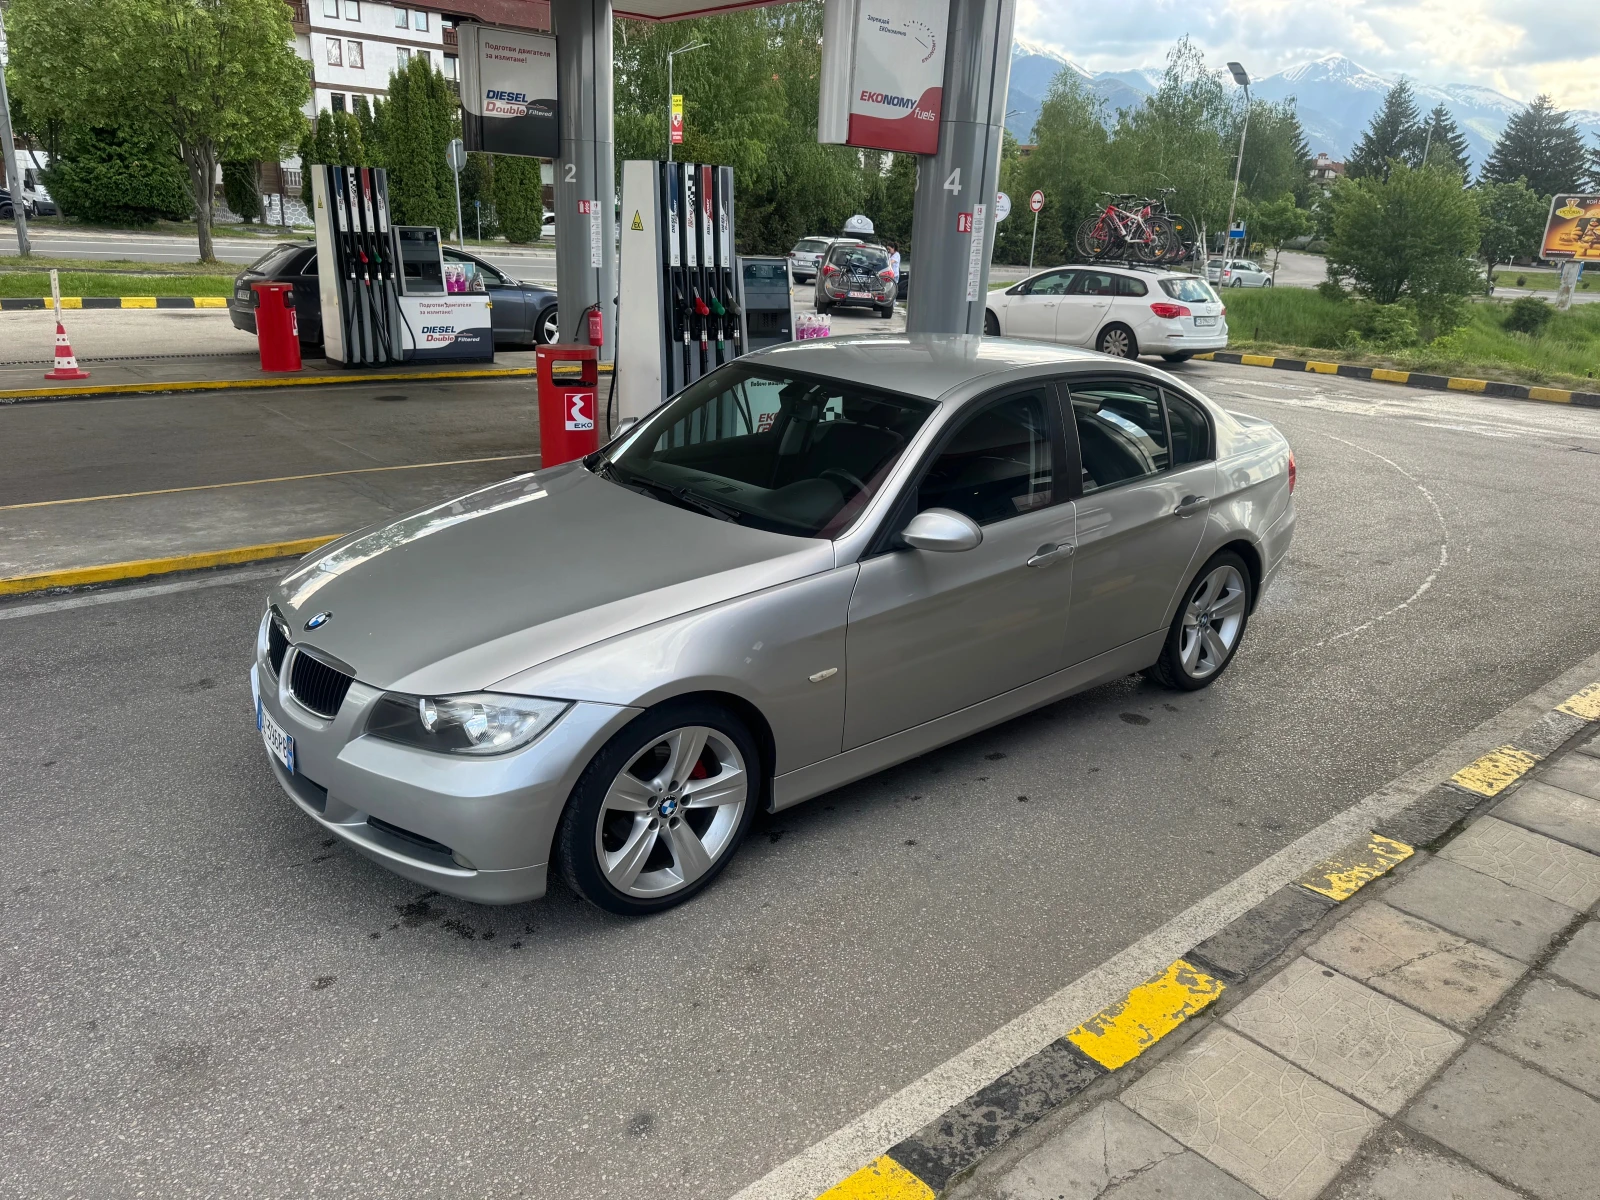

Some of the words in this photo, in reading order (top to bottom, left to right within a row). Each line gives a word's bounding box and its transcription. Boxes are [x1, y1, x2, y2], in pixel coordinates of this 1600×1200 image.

[485, 41, 517, 53] Подготви
[518, 47, 551, 58] двигателя
[494, 54, 528, 64] излитане!
[486, 89, 529, 103] DIESEL
[860, 90, 918, 110] EKONOMY
[485, 101, 526, 115] Double
[528, 109, 553, 117] Filtered
[914, 107, 936, 122] fuels
[565, 163, 577, 183] 2
[943, 167, 962, 196] 4
[422, 326, 456, 334] DIESEL
[426, 334, 454, 342] Double
